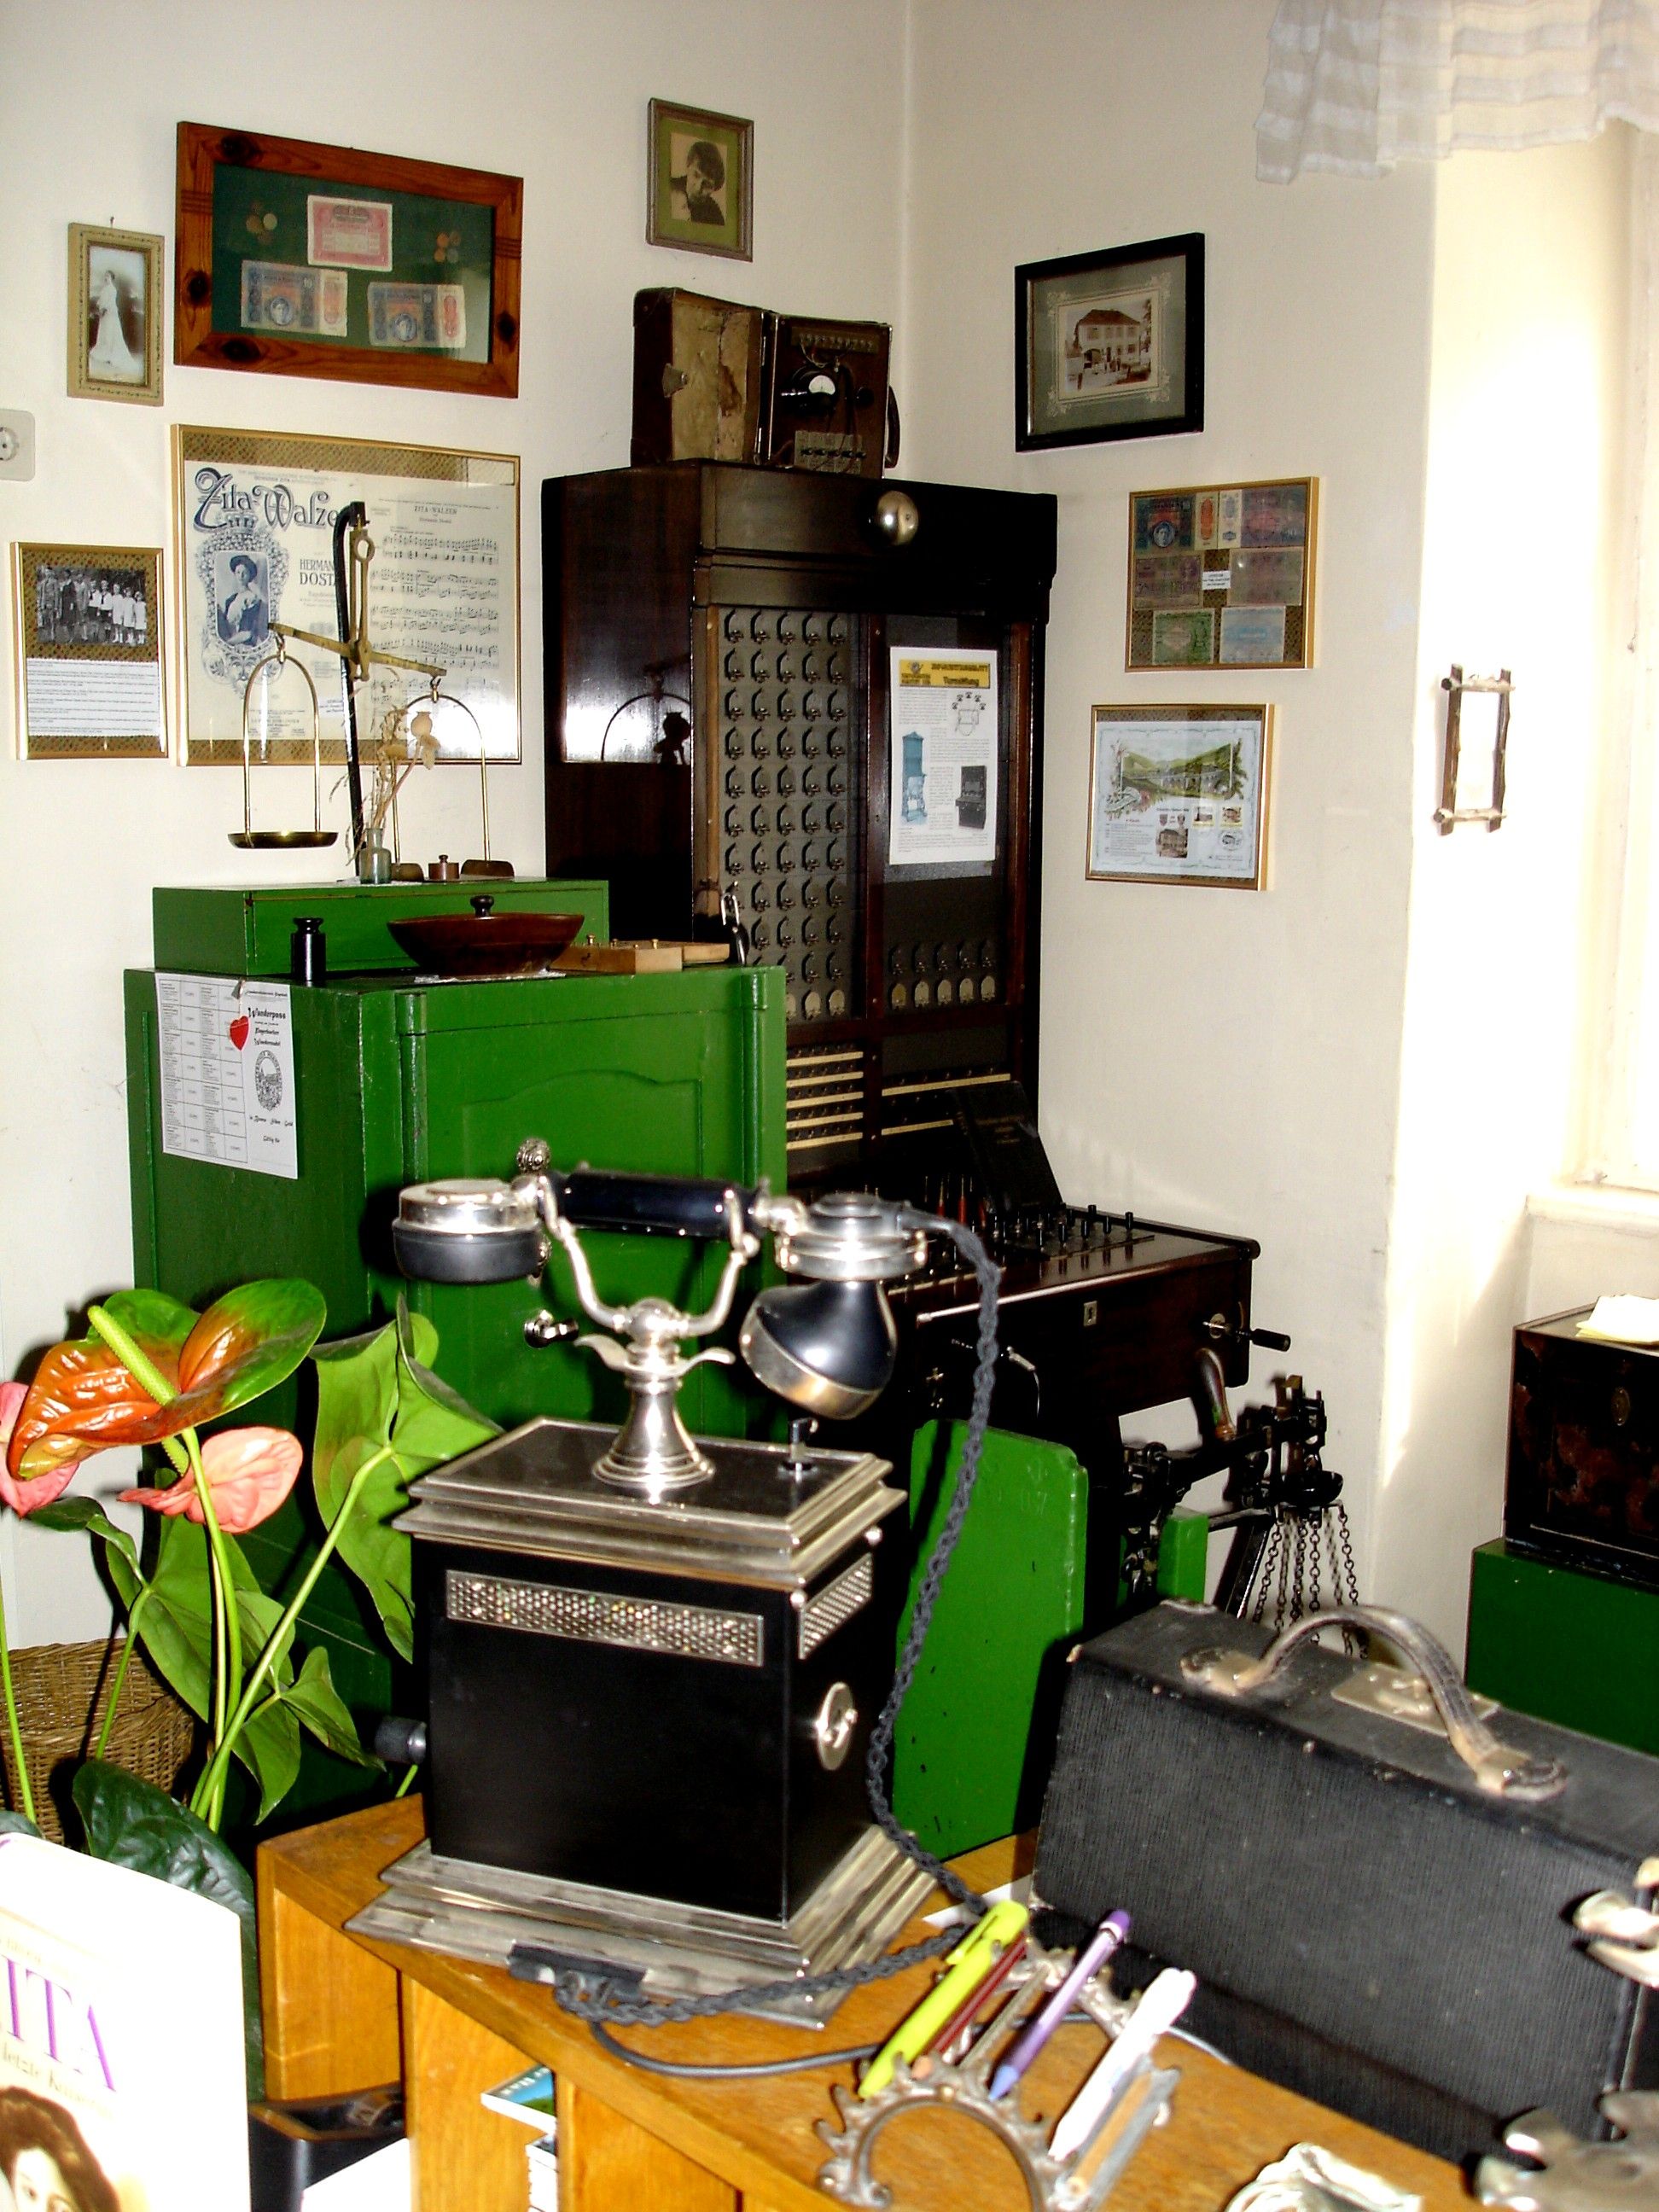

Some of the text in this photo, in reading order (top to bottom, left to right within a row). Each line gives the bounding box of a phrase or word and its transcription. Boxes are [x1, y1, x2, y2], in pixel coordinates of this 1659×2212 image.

[252, 484, 340, 531] Walze
[300, 559, 335, 571] HERMAN
[300, 572, 335, 586] DOST
[0, 1953, 116, 2093] ITA
